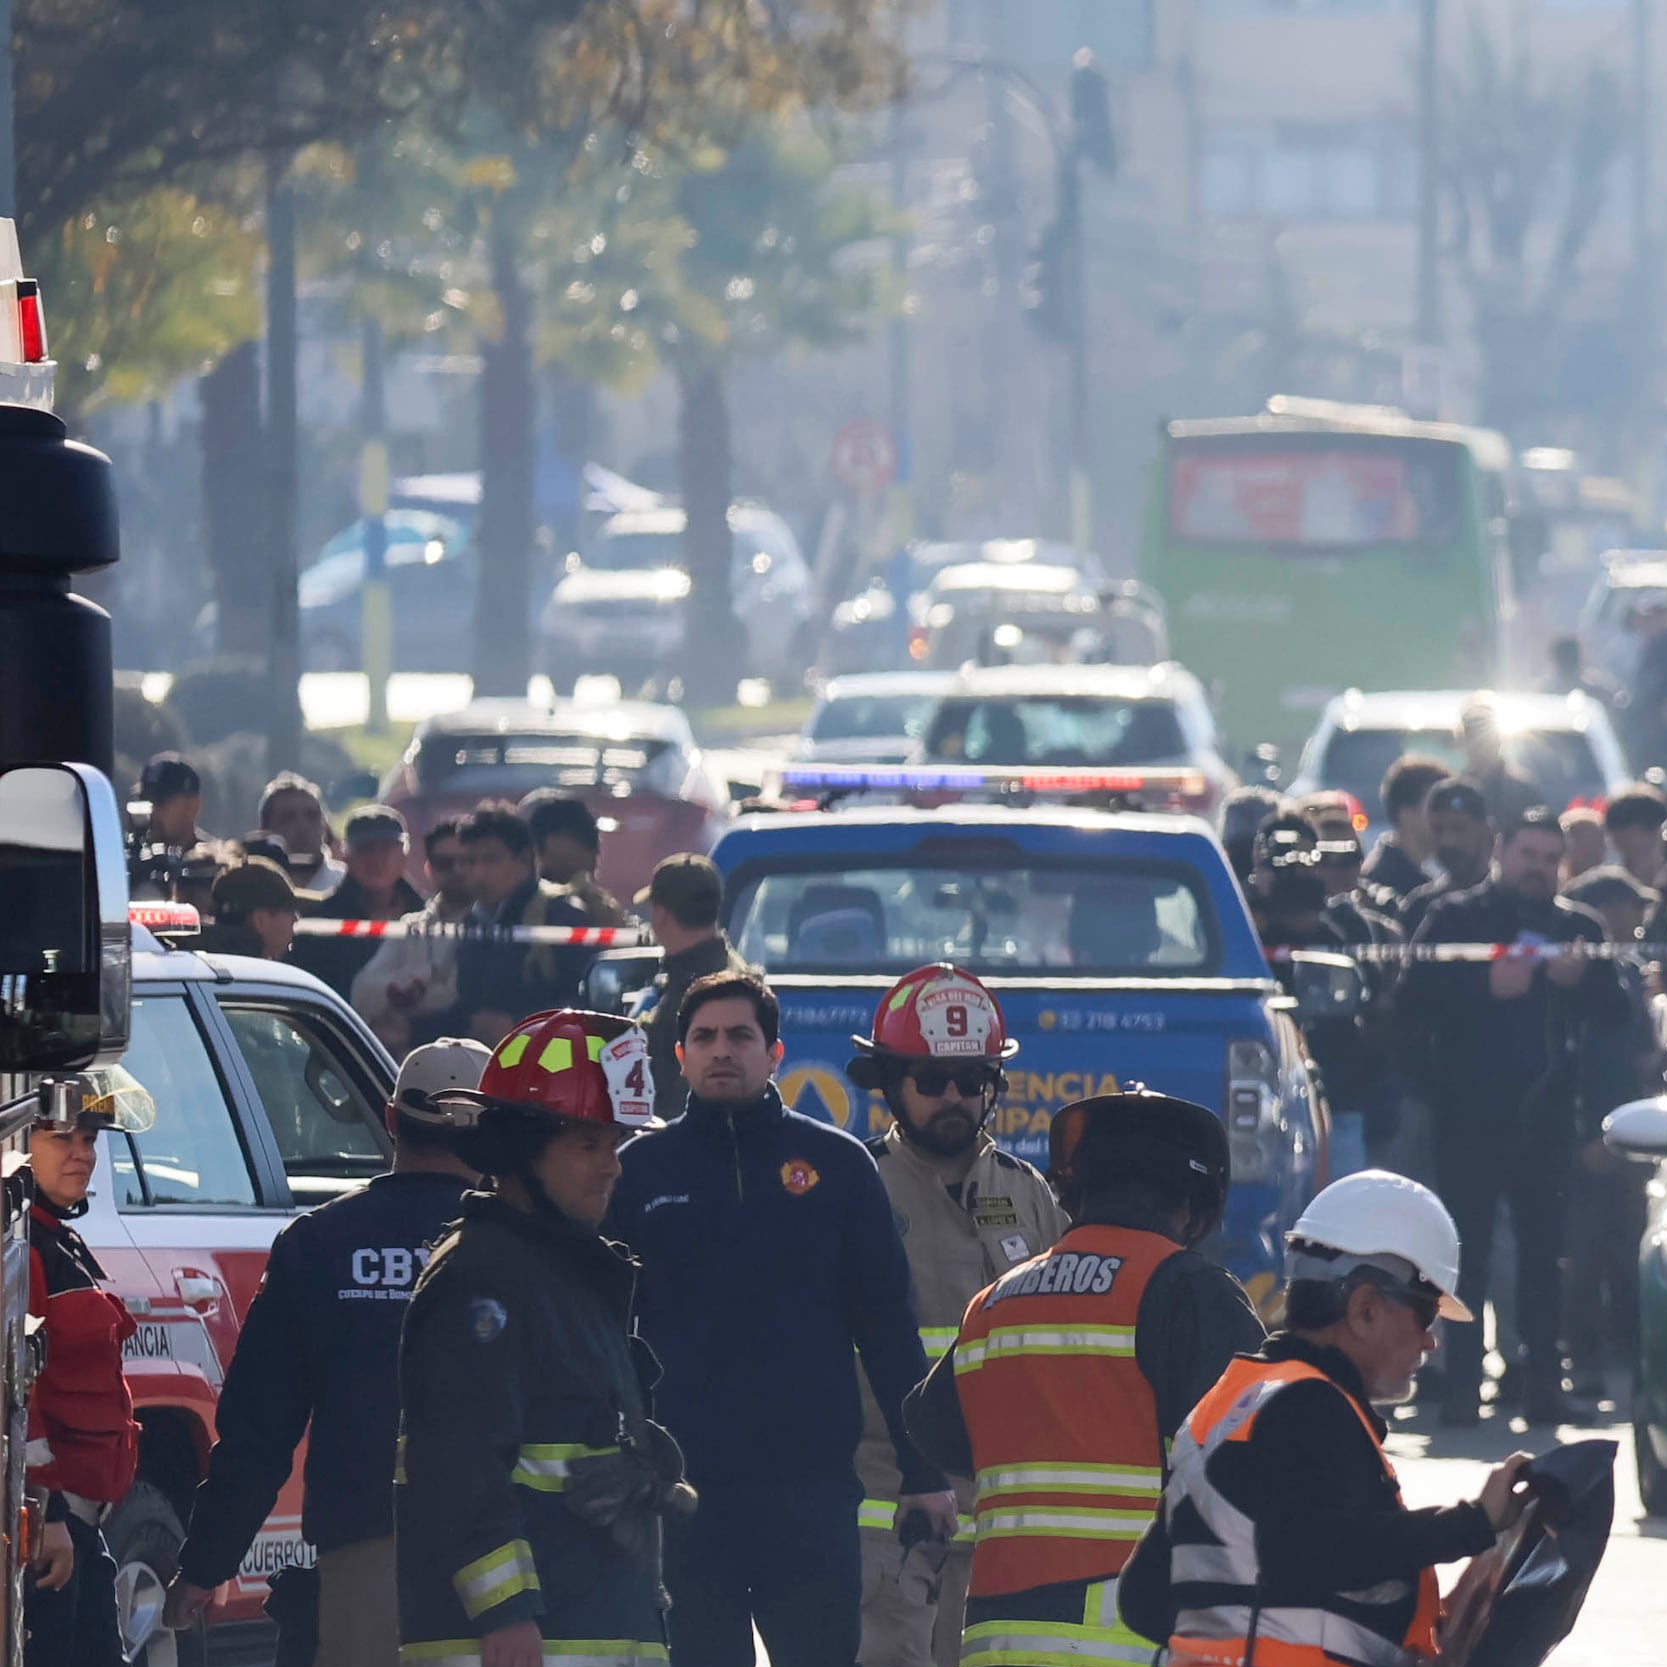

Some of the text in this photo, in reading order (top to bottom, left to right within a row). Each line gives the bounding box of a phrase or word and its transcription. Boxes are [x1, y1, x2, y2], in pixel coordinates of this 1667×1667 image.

[946, 1005, 968, 1037] 9
[625, 1059, 645, 1097] 4
[243, 1540, 305, 1573] CUERPO
